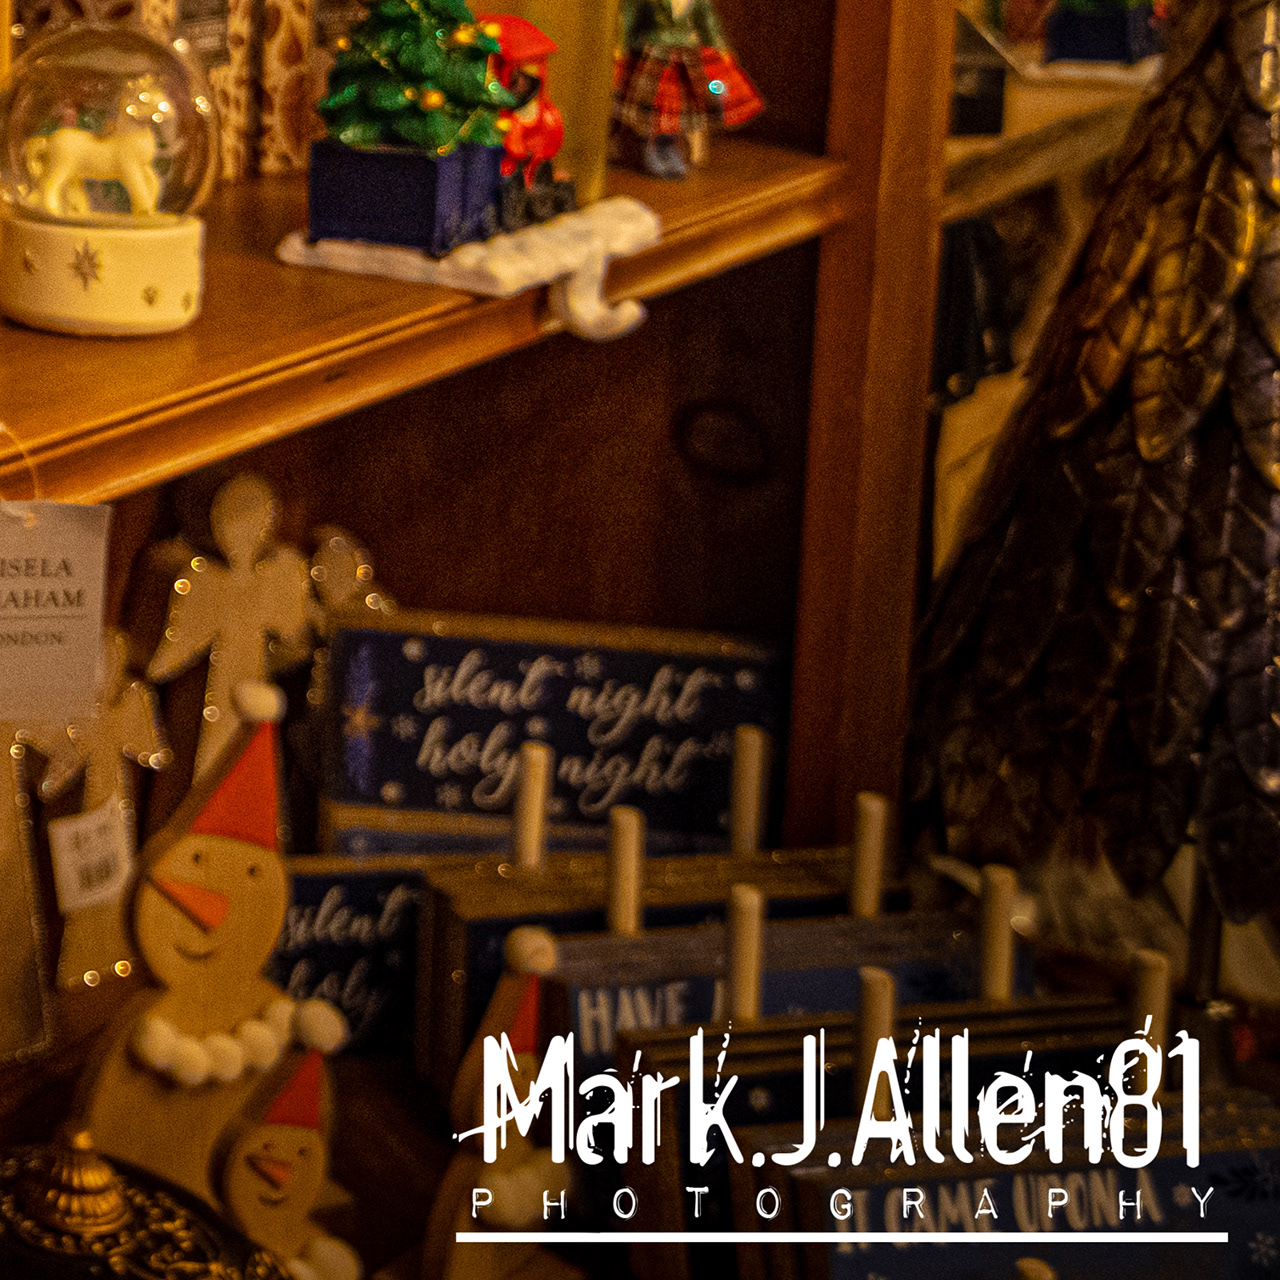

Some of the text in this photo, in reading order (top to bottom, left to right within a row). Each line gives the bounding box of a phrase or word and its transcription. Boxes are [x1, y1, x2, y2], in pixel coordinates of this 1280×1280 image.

[413, 648, 725, 750] silent night
[415, 716, 710, 817] holy night
[1012, 1168, 1121, 1232] UPON
